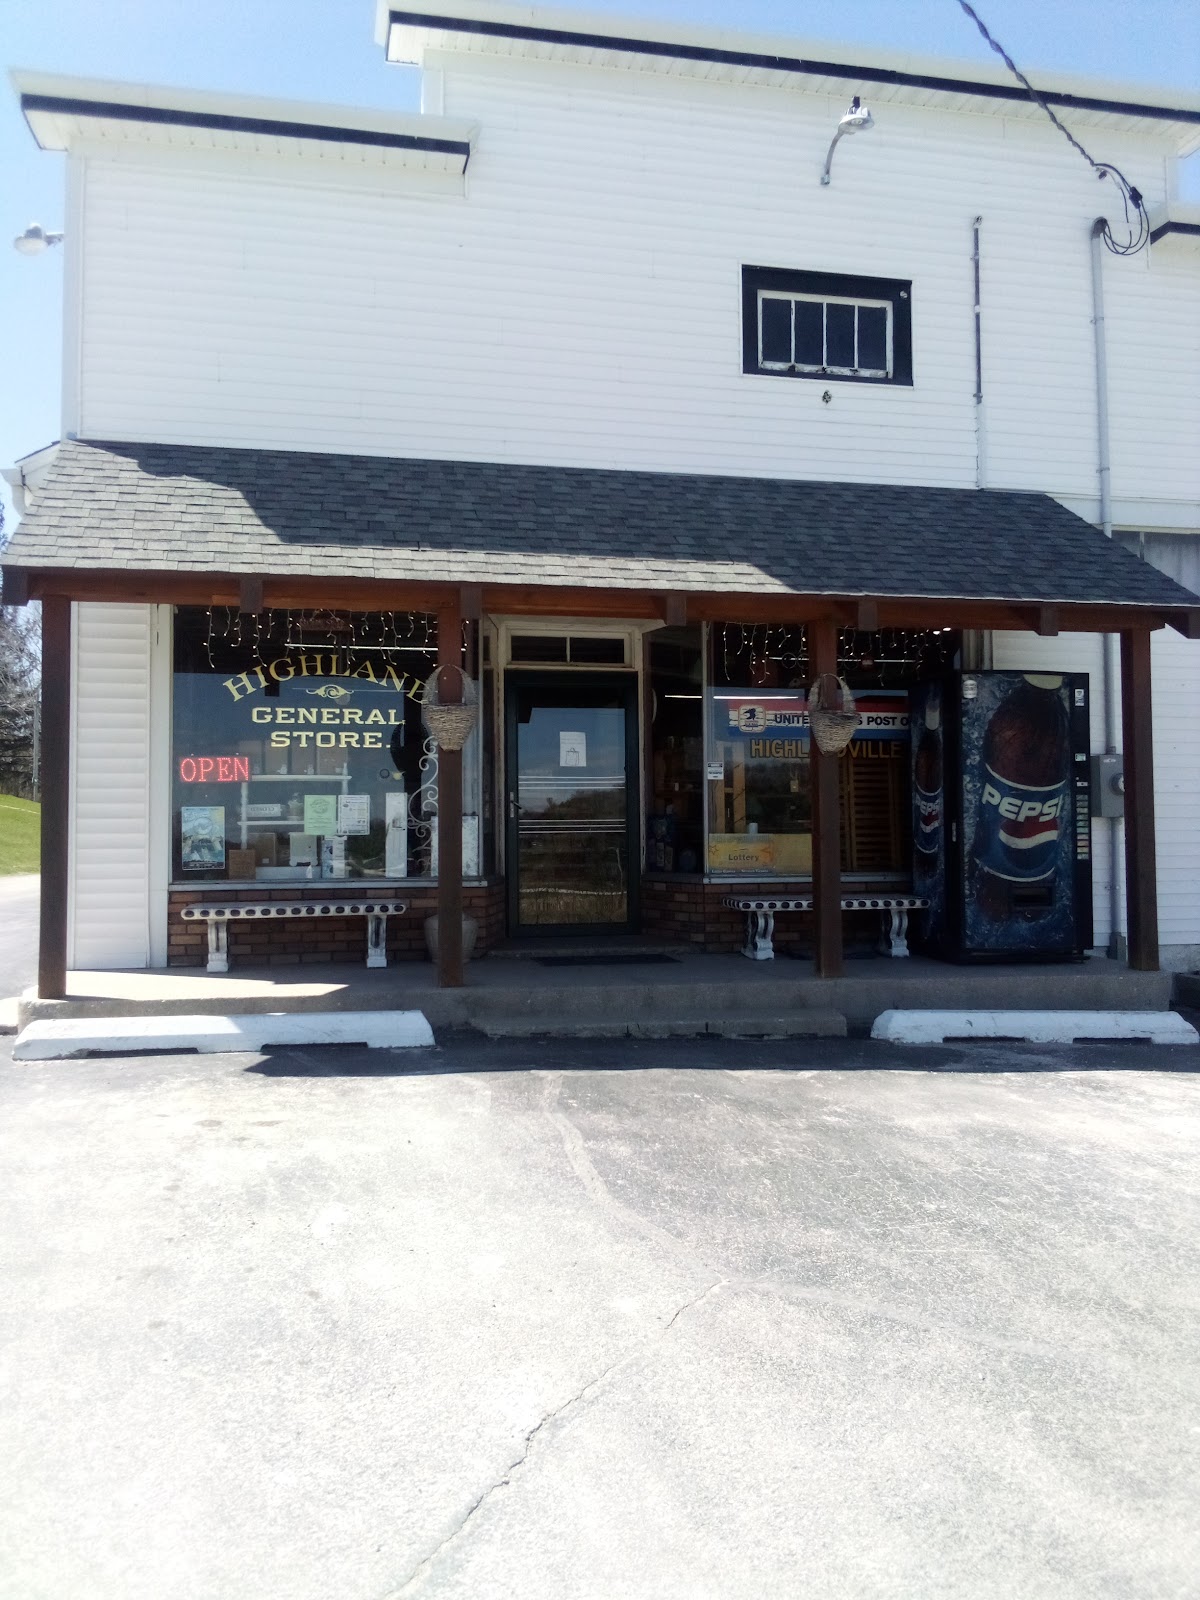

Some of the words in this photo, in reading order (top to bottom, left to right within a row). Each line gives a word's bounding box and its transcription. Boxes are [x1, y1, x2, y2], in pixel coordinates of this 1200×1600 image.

[251, 706, 406, 725] GENERAL
[774, 714, 809, 725] UNITE
[866, 716, 898, 726] POST
[270, 730, 391, 748] STORE.
[180, 757, 249, 782] OPEN
[981, 782, 1063, 822] PEPSI
[728, 853, 760, 862] Lottery
